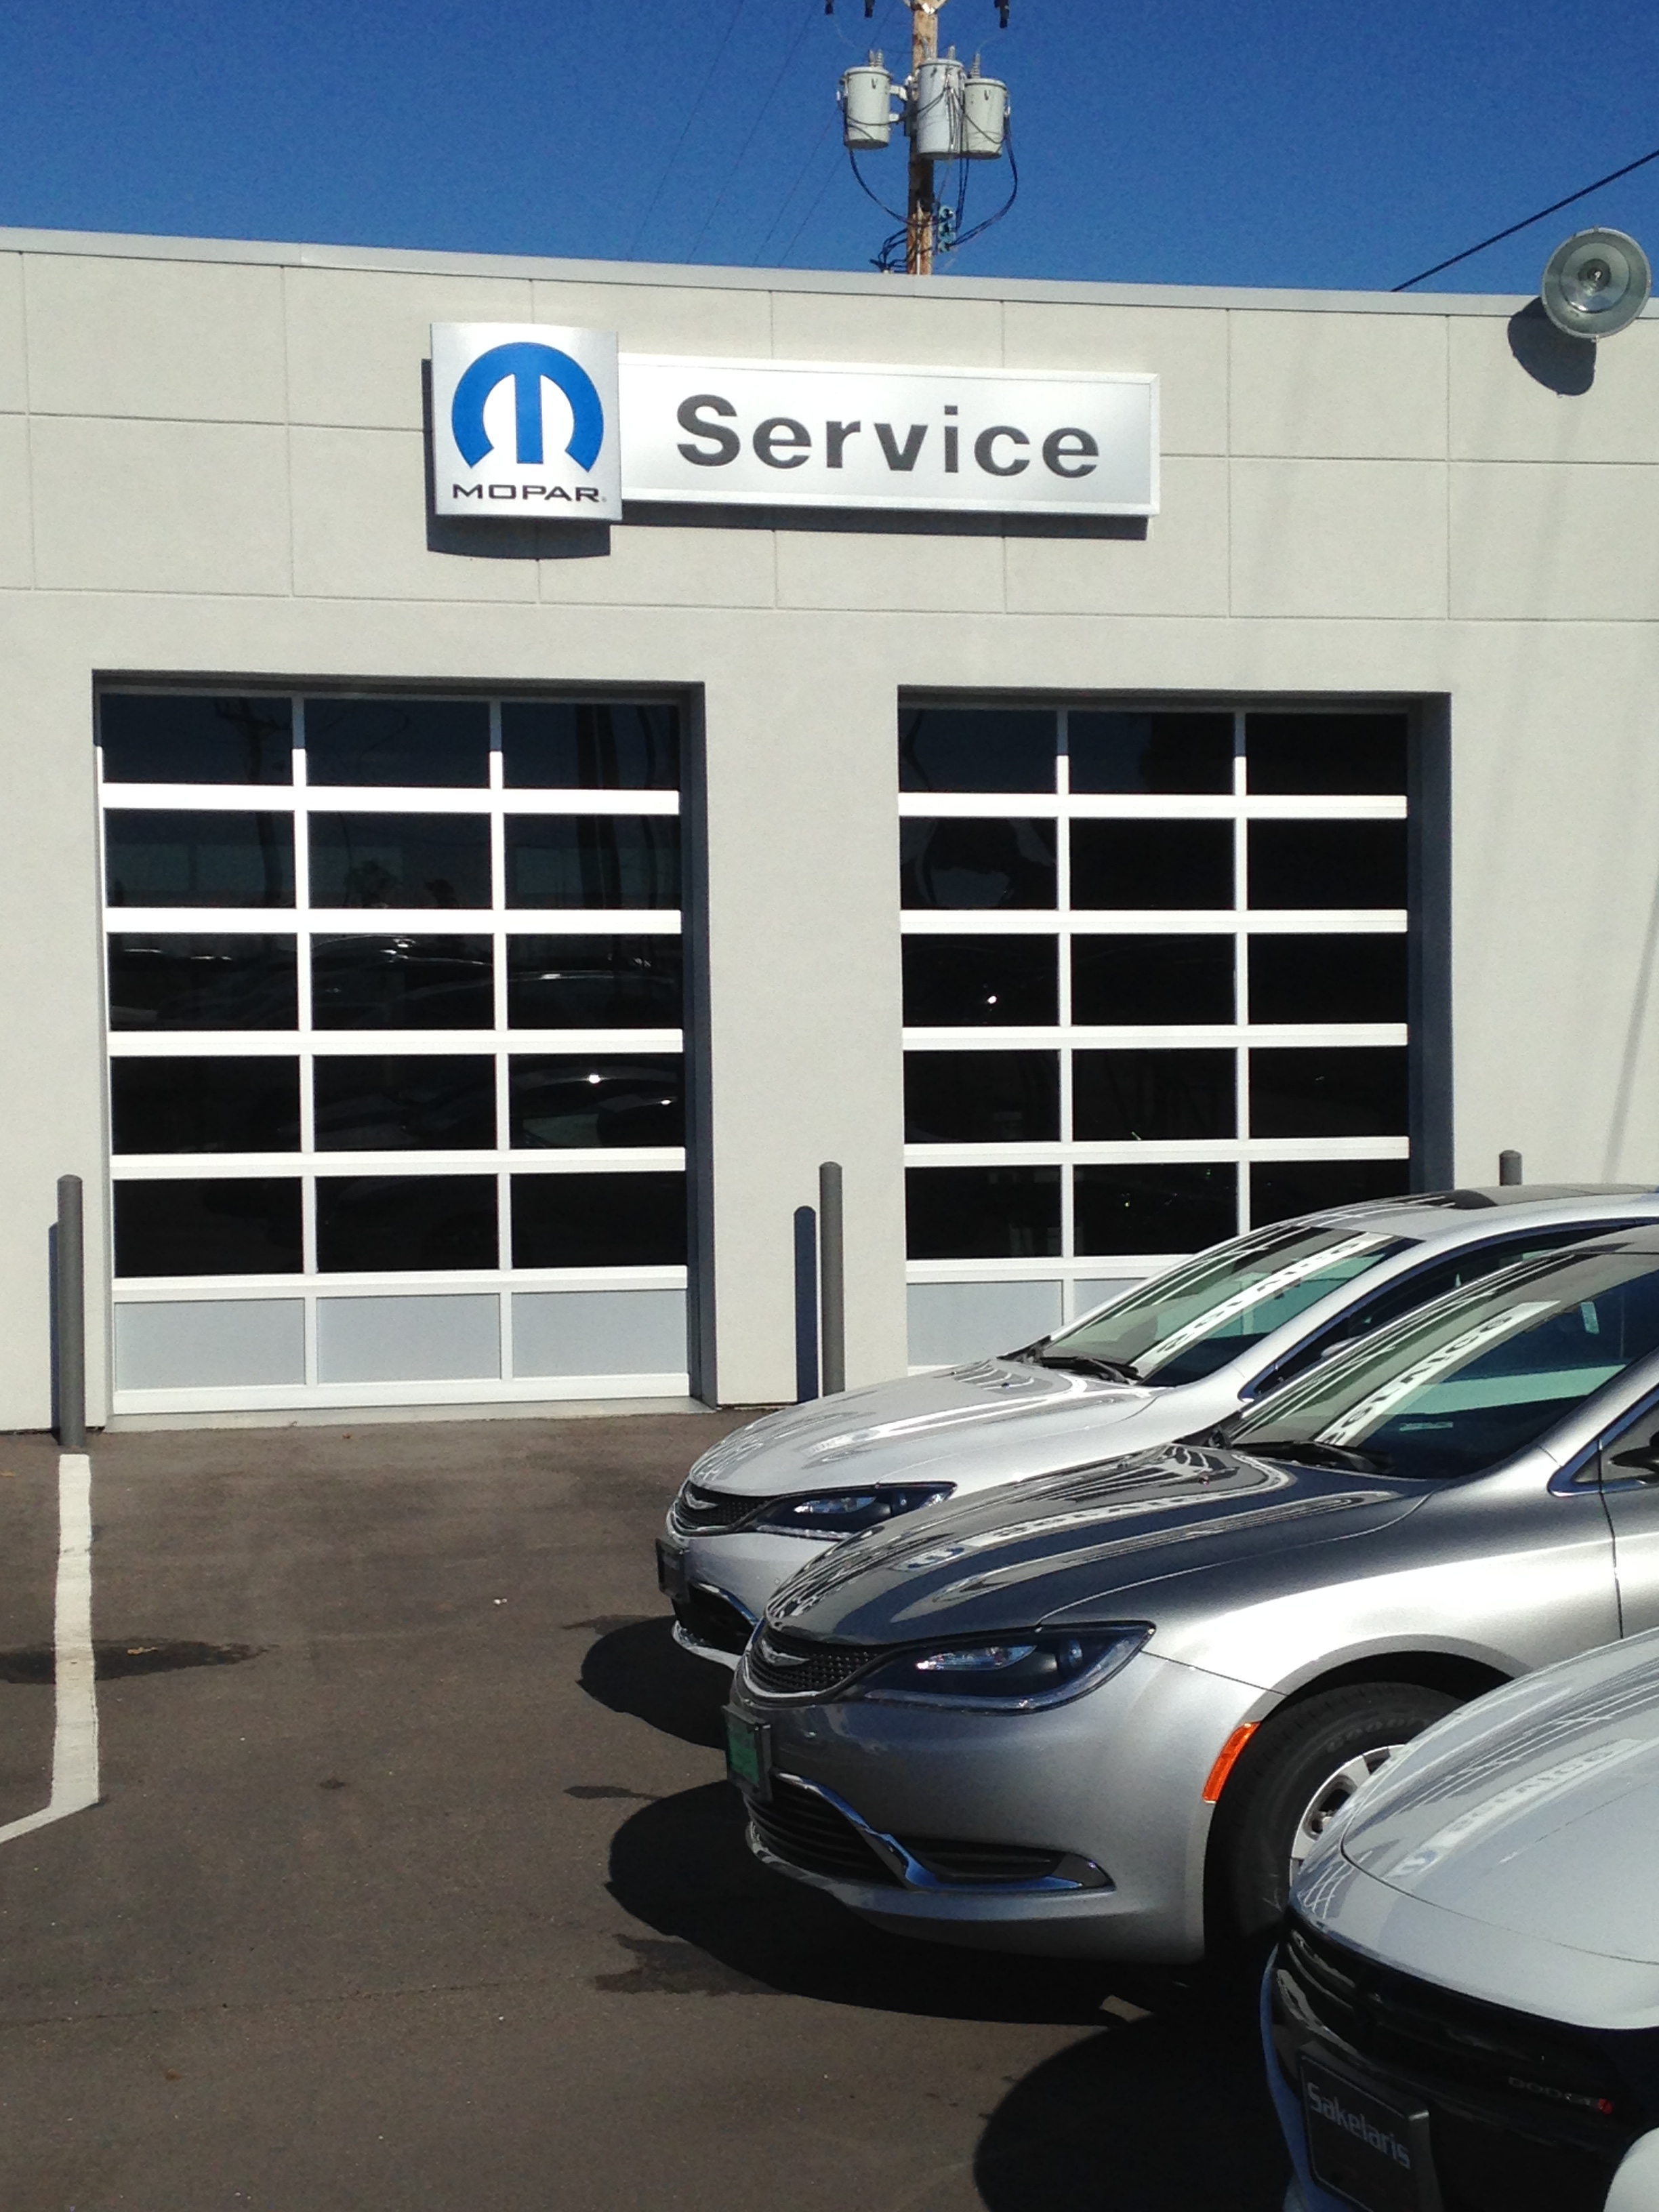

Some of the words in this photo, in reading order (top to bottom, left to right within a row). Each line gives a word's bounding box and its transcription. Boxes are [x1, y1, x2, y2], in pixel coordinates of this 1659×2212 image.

[676, 393, 1099, 478] Service
[452, 483, 600, 503] MOPAR
[1306, 2081, 1412, 2171] Sakelaris
